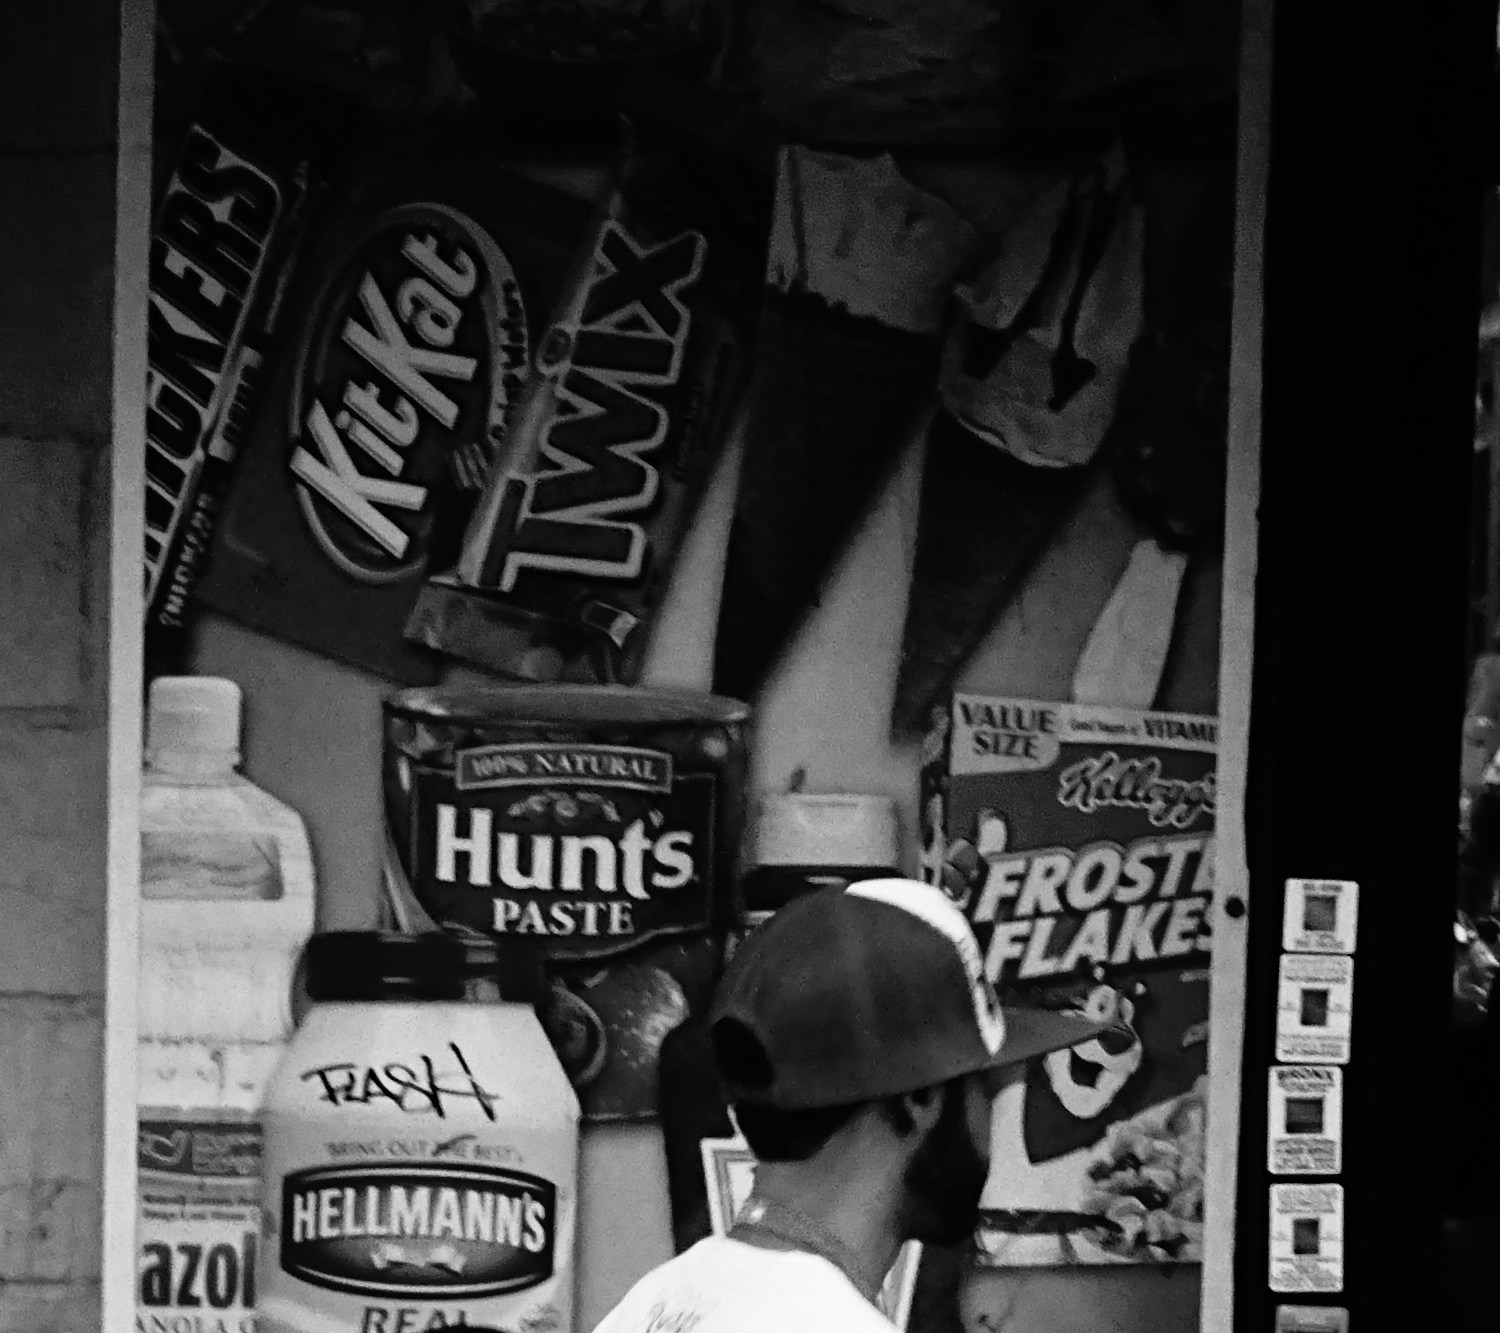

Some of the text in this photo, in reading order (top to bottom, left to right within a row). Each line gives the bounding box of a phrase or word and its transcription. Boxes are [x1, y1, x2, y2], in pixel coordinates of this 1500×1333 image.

[479, 217, 708, 593] TWIX
[959, 701, 1056, 734] VALUE
[972, 730, 1040, 760] SIZE
[533, 752, 658, 782] NATURAL
[435, 803, 695, 900] Hunt's
[491, 898, 636, 937] PASTE
[291, 1184, 547, 1253] HELLMANN'S
